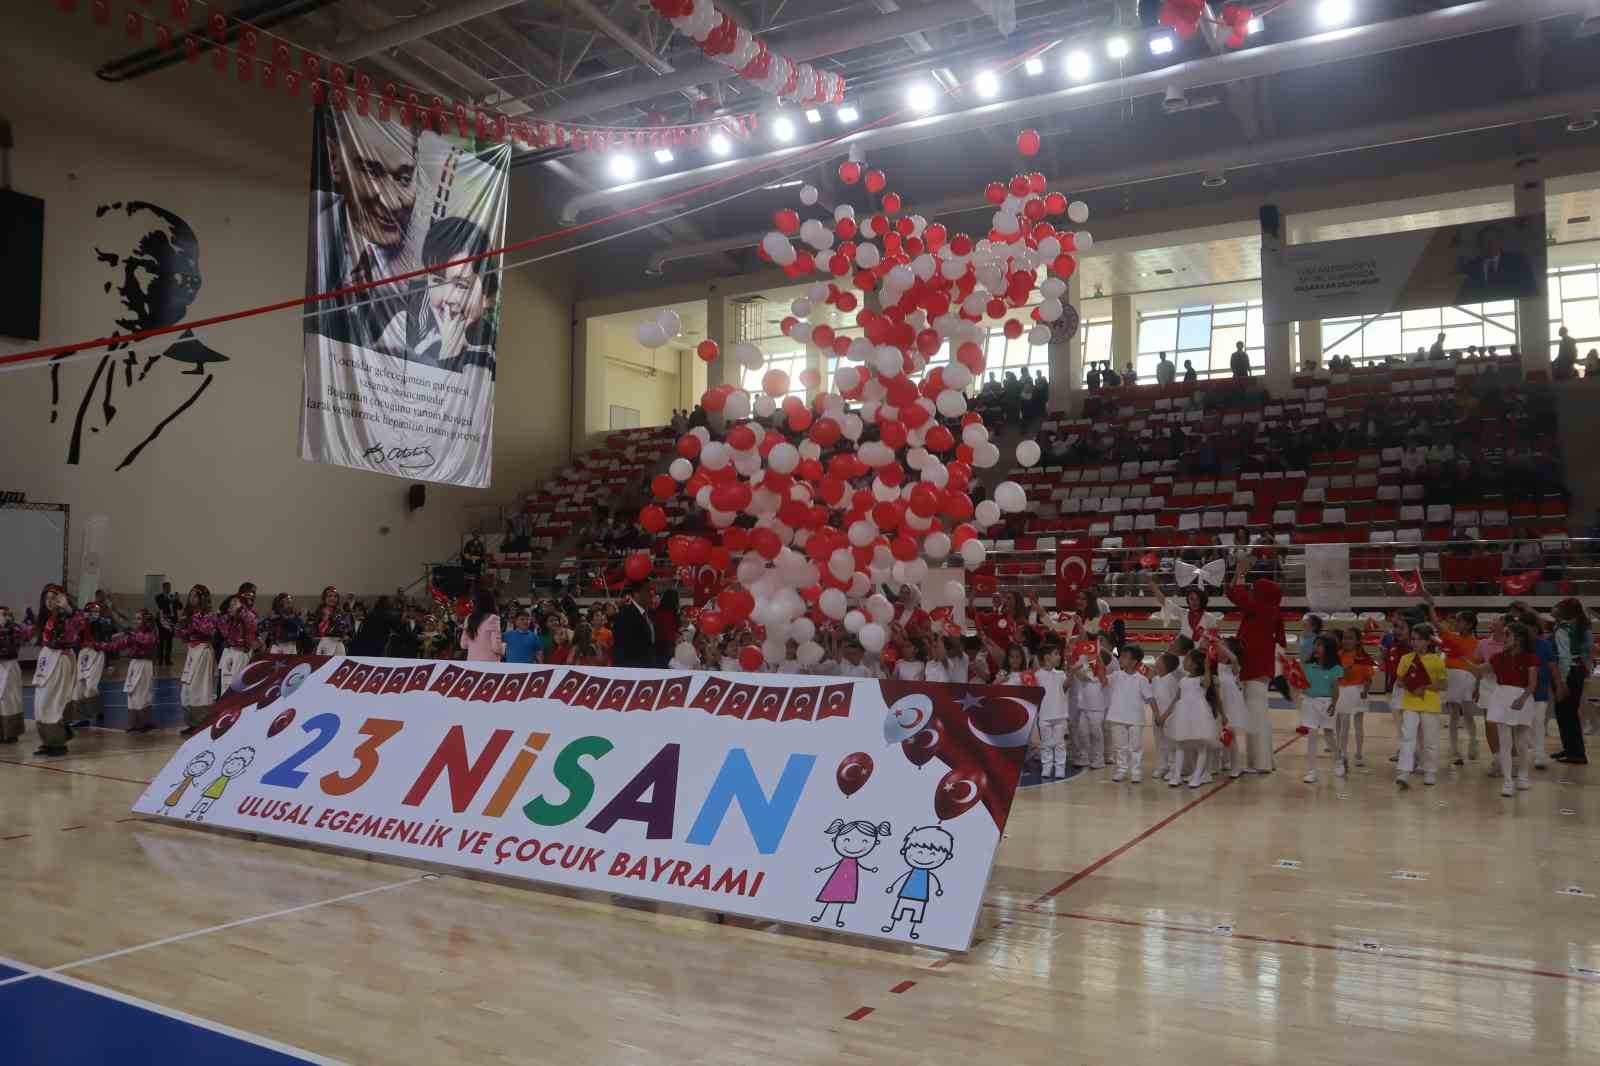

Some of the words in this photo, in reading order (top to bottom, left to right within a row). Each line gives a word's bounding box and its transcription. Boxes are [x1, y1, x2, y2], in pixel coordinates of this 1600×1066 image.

[260, 713, 405, 796] 23
[237, 795, 314, 825] ULUSAL
[315, 808, 453, 848] EGEMENLİK
[457, 829, 493, 854] VE
[494, 836, 605, 873] ÇOCUK
[608, 852, 766, 898] BAYRAMI
